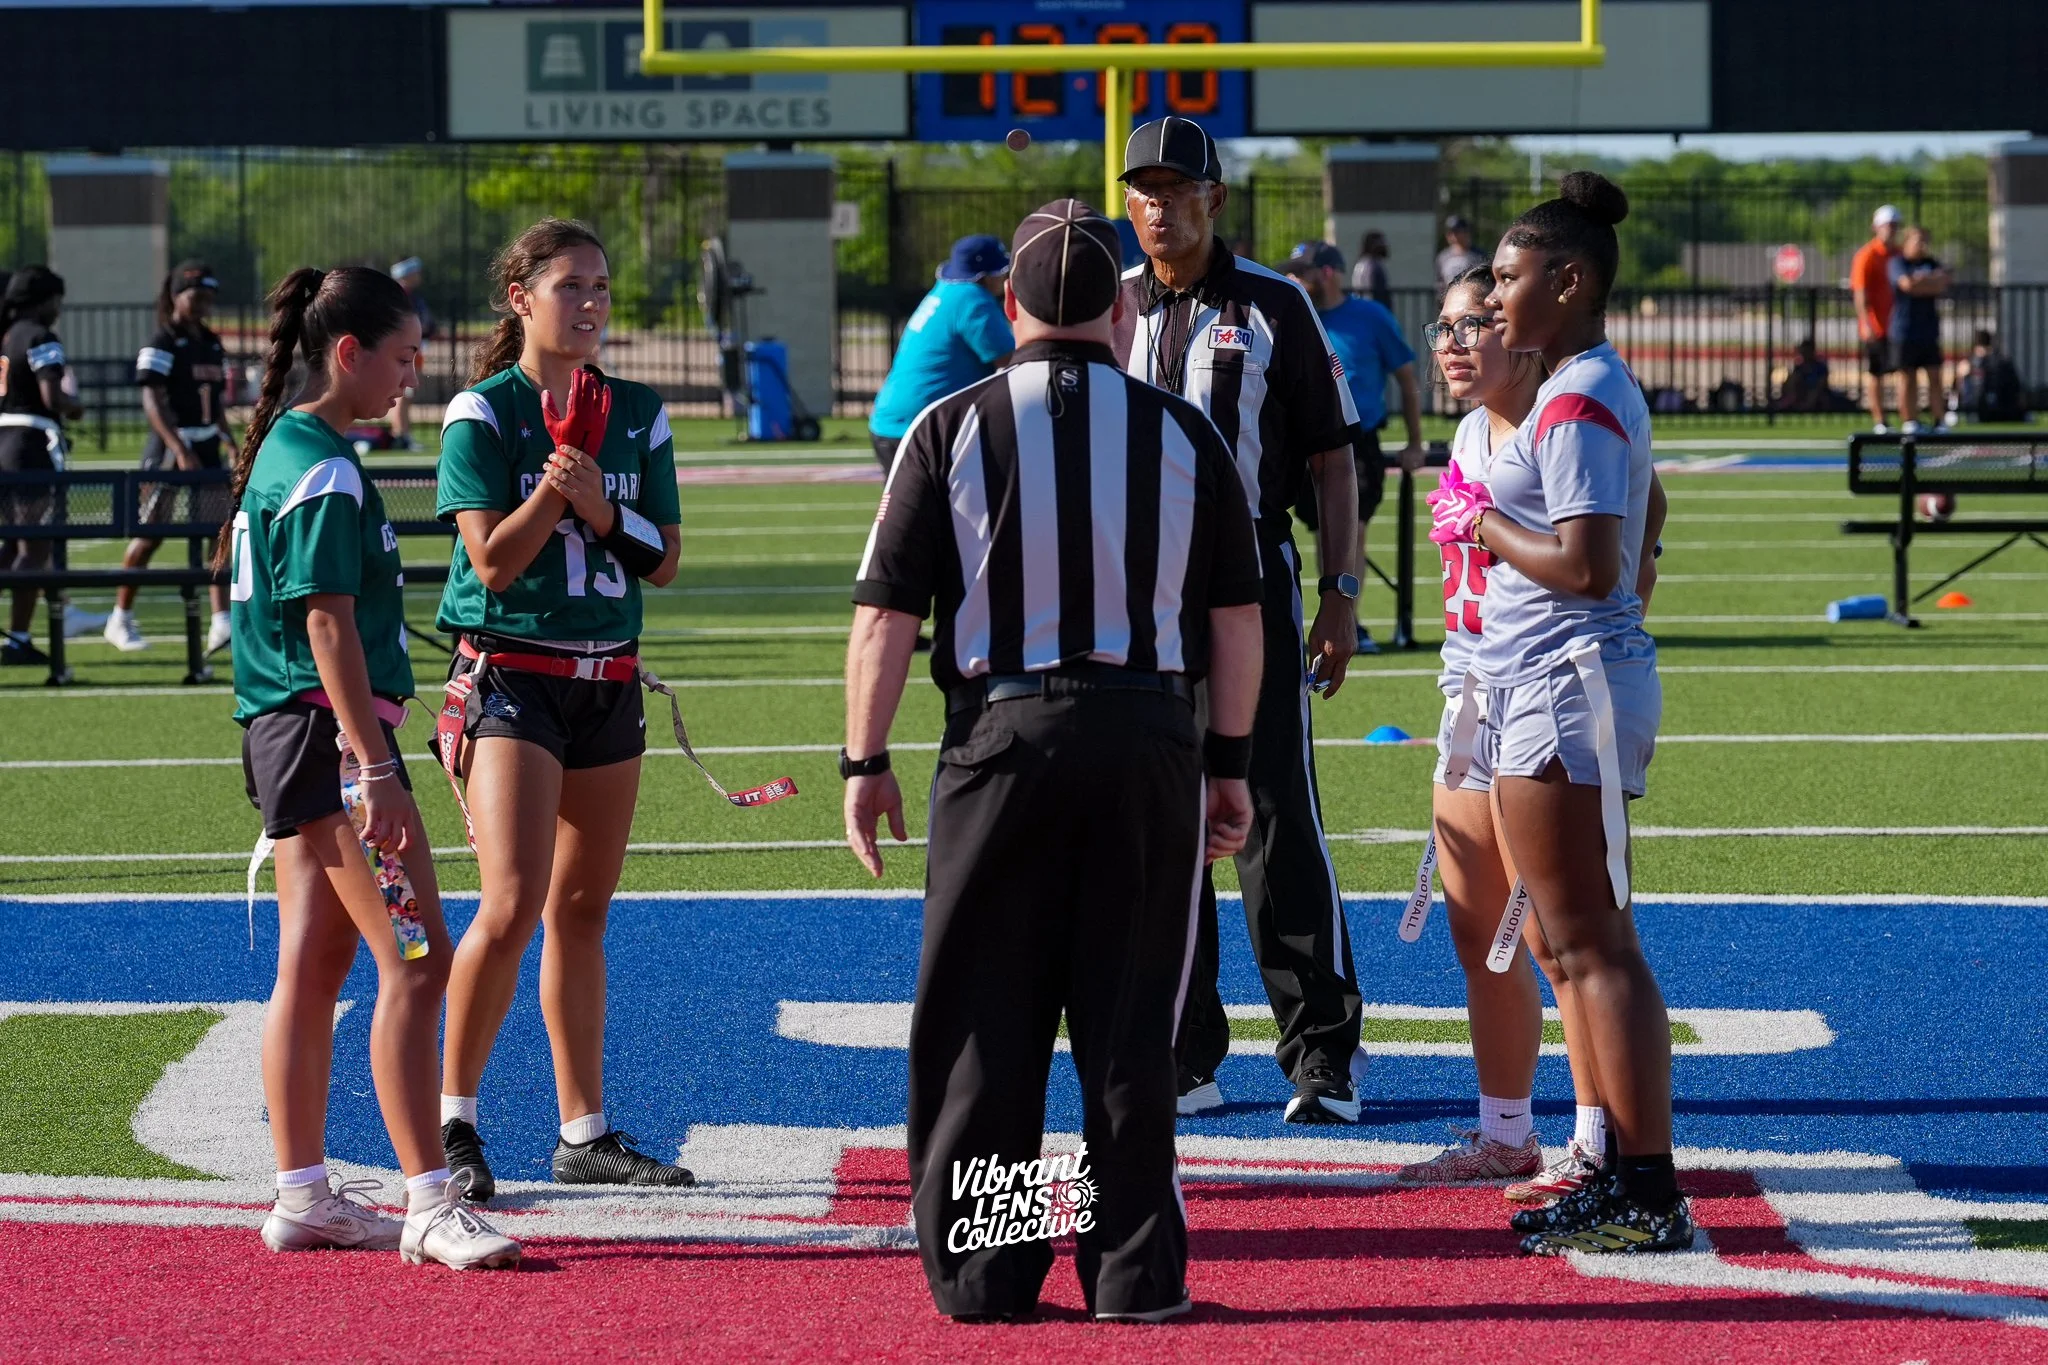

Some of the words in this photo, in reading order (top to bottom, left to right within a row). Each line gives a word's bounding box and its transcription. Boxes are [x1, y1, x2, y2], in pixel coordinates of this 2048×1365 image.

[524, 99, 667, 130] LIVING
[686, 98, 832, 129] SPACES
[1440, 542, 1498, 636] 25
